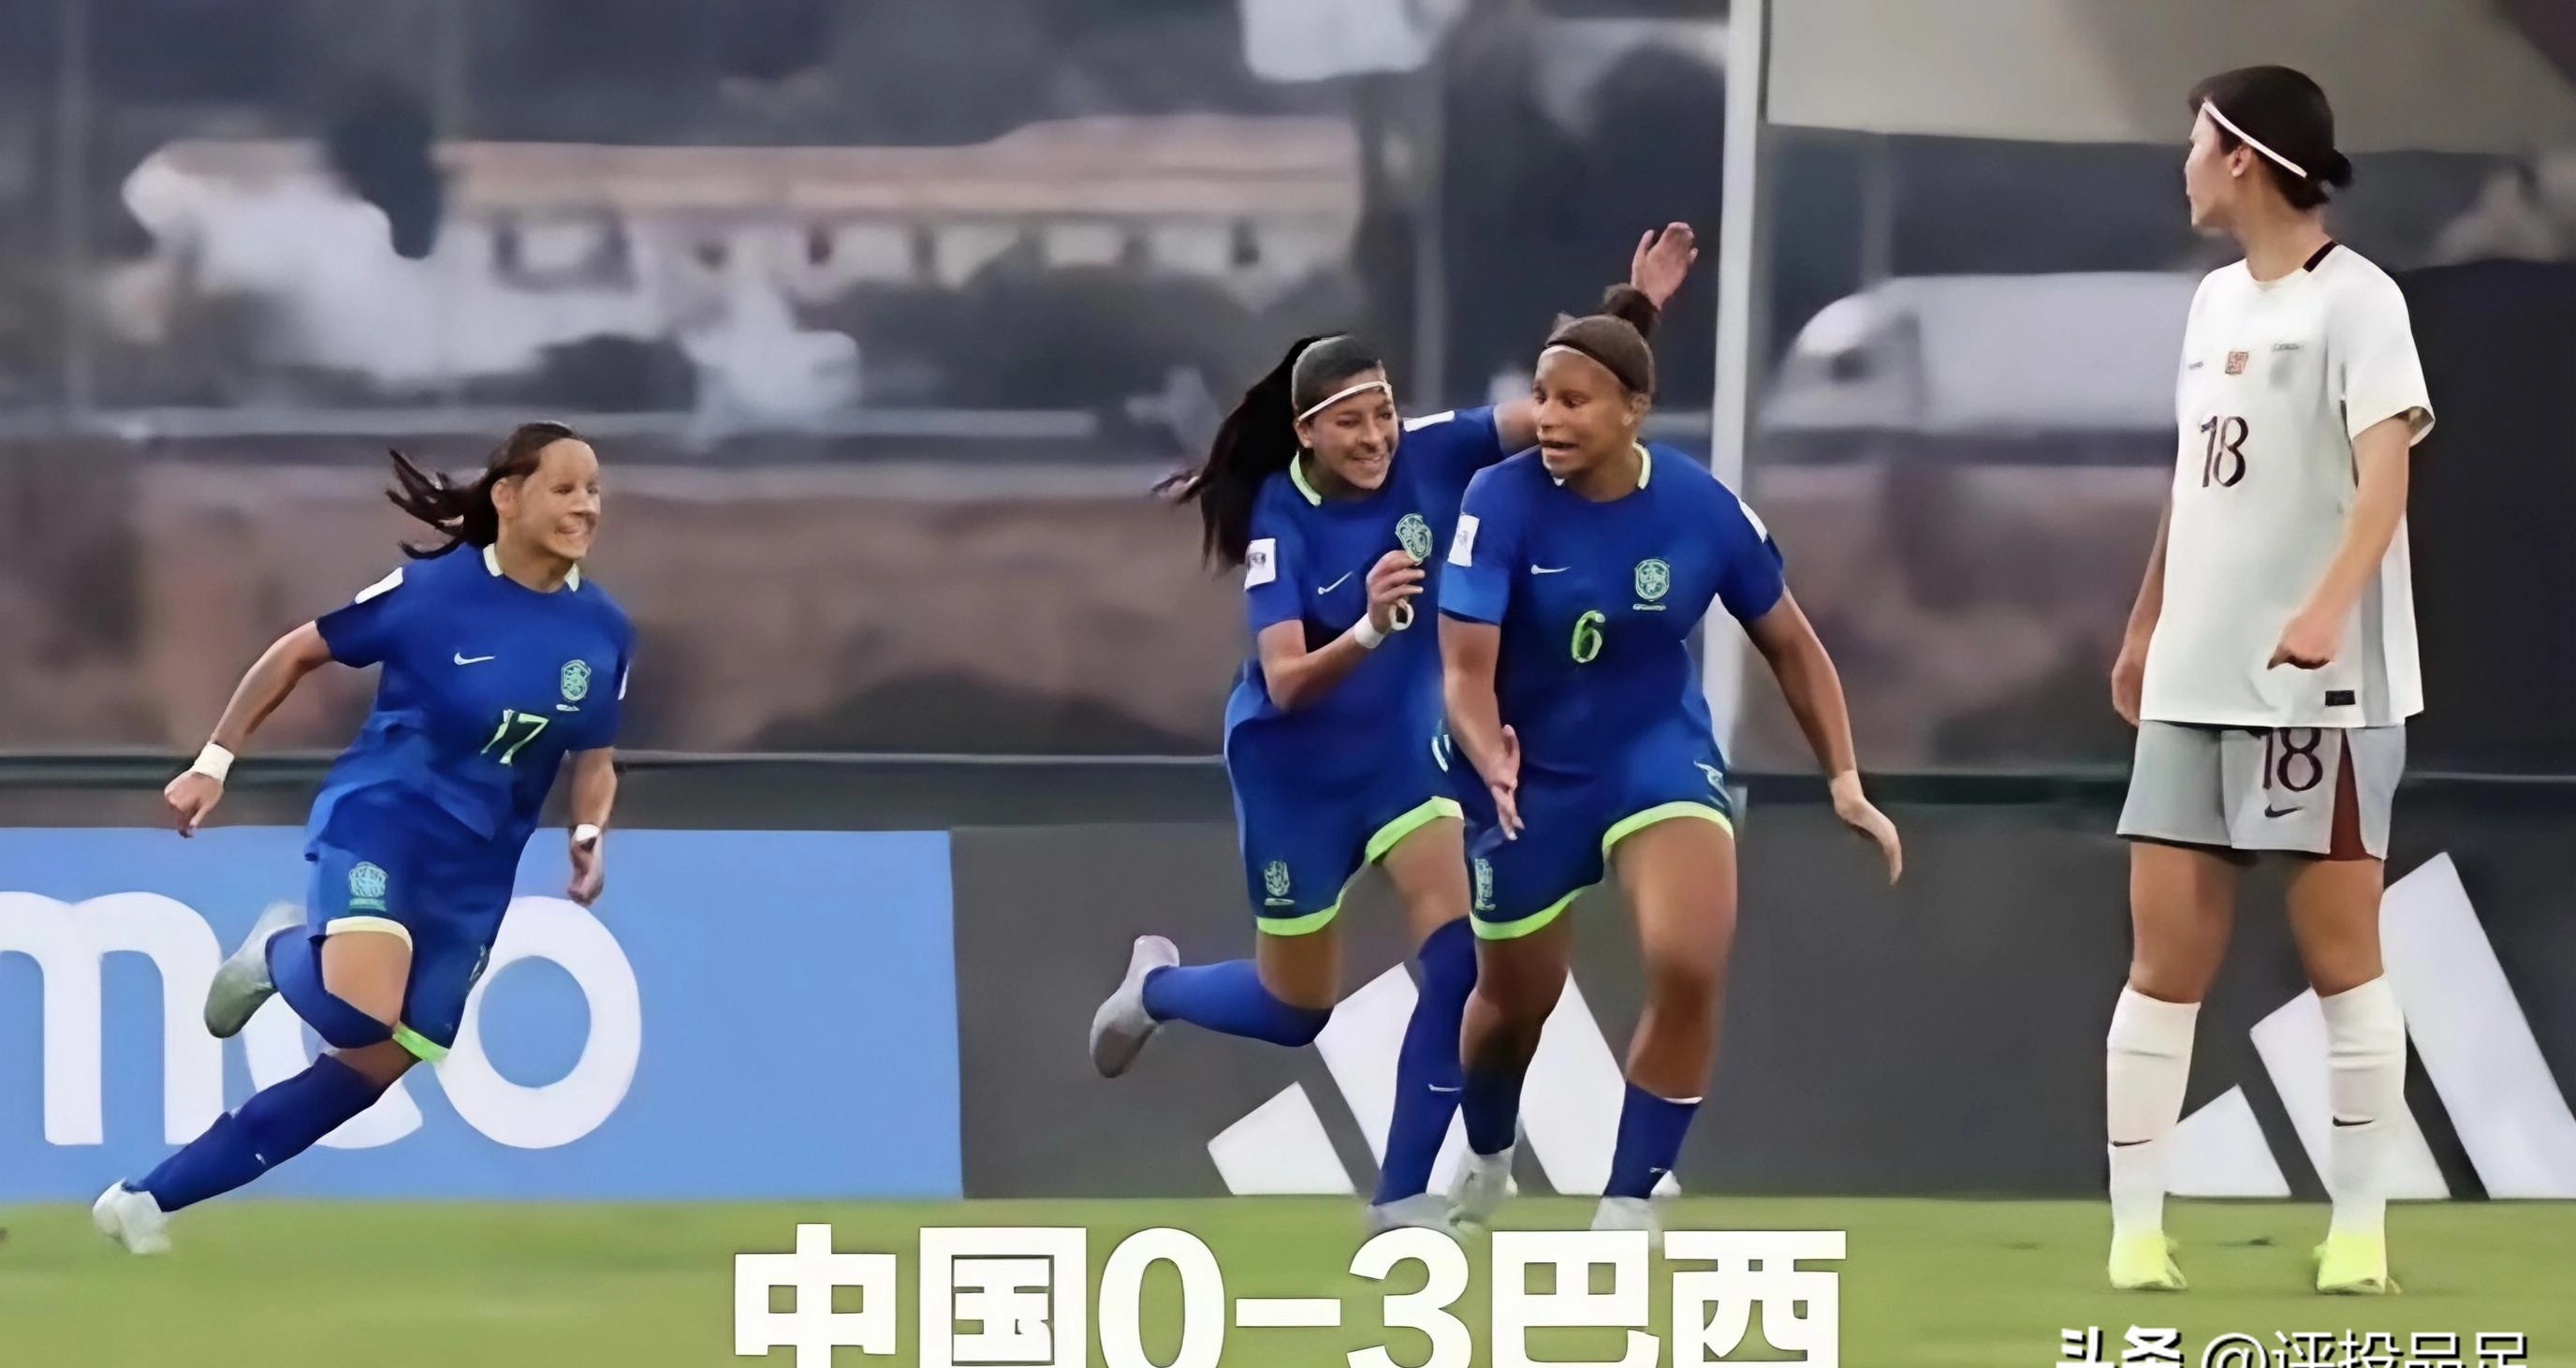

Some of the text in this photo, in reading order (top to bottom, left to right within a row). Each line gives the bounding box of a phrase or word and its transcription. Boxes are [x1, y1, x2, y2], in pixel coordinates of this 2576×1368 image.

[2200, 415, 2248, 488] 18
[1570, 609, 1606, 664] 6
[480, 708, 549, 766] 17
[2260, 728, 2323, 792] 18
